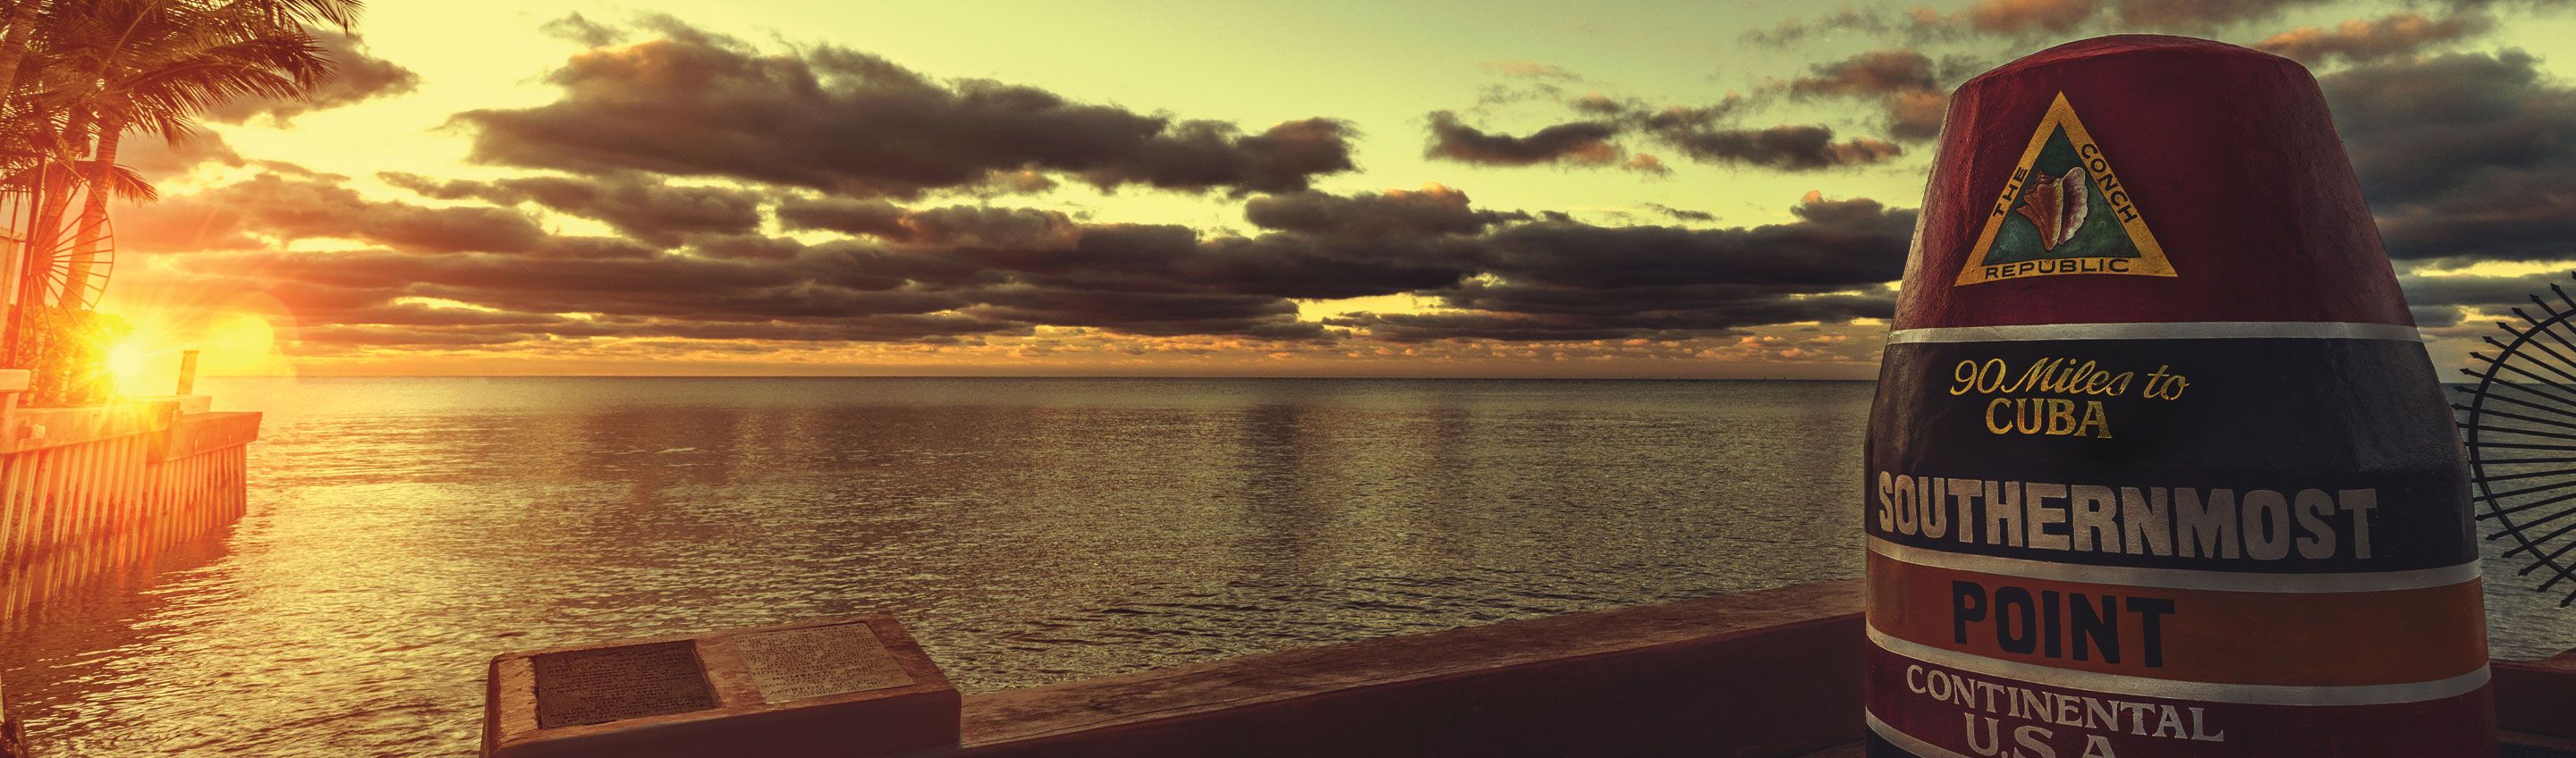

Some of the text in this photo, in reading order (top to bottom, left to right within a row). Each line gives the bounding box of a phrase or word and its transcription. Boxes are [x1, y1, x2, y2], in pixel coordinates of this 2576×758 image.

[1993, 143, 2139, 223] THE CONCH
[1985, 259, 2130, 280] REPUBLIC
[1950, 357, 2190, 400] 90 Miles to
[1986, 398, 2113, 439] CUBA
[1878, 470, 2377, 560] SOUTHERNMOST
[1952, 580, 2175, 668] POINT
[1906, 664, 2224, 742] CONTINENTAL
